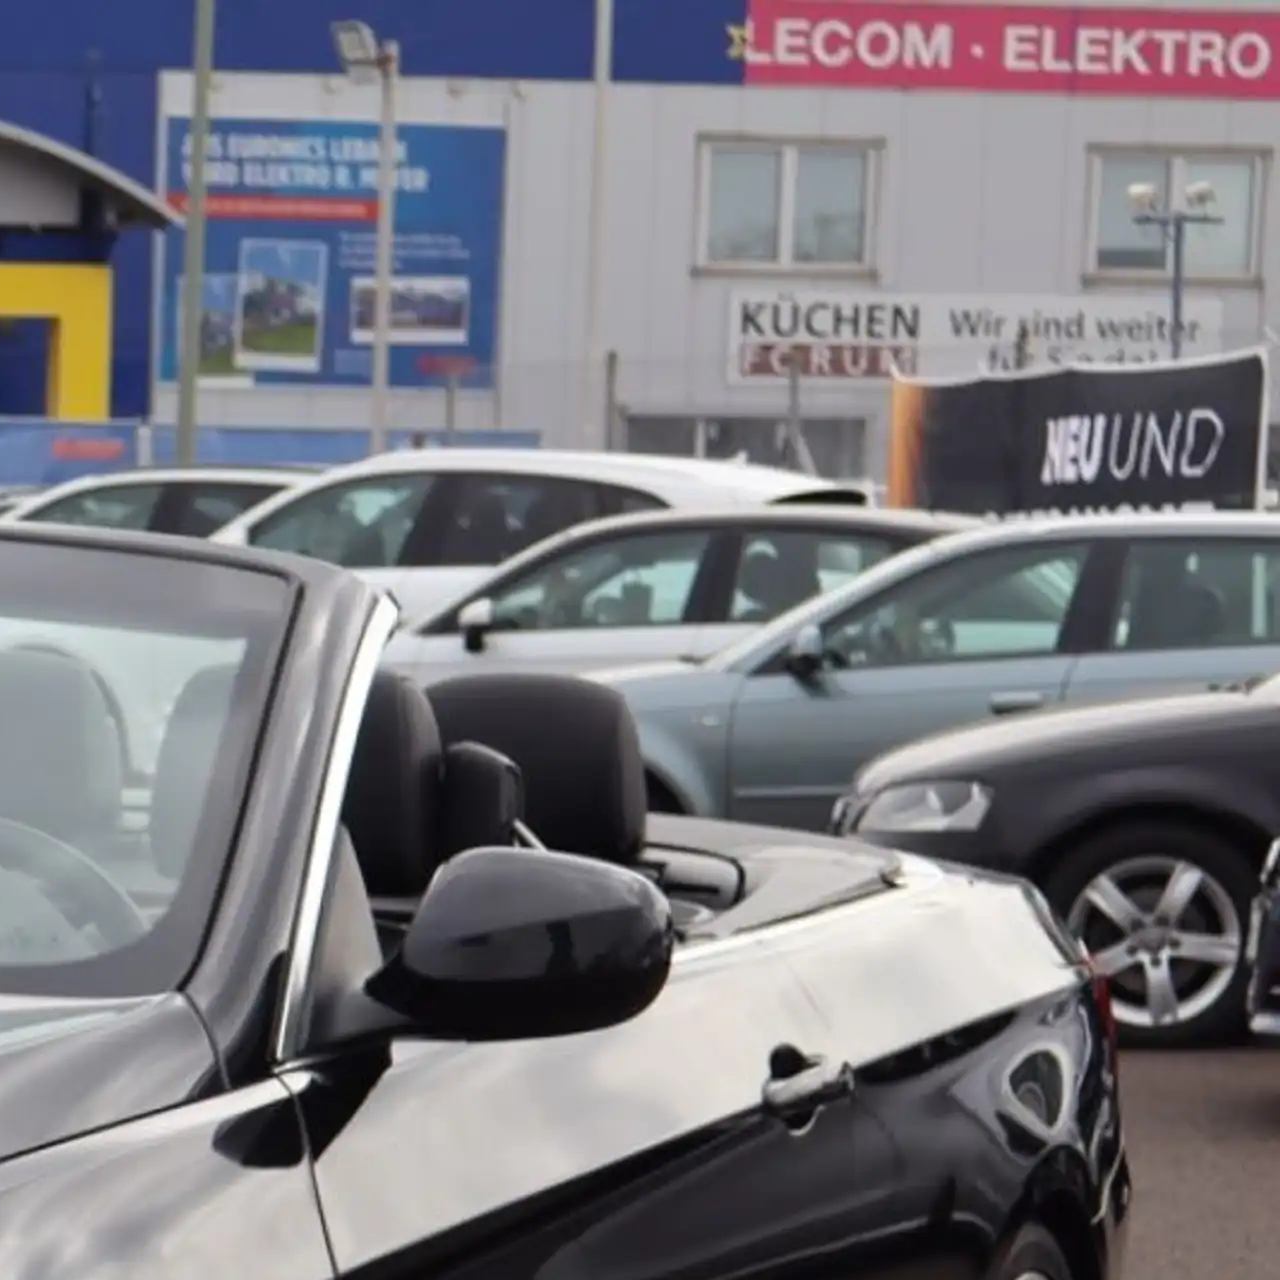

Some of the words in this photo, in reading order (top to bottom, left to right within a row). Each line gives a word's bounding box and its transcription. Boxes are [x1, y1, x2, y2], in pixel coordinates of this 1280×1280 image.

[1002, 24, 1272, 79] ELEKTRO
[741, 293, 920, 339] KÜCHEN
[948, 307, 1006, 338] Wir
[1041, 413, 1107, 485] NEU
[1108, 409, 1224, 480] UND
